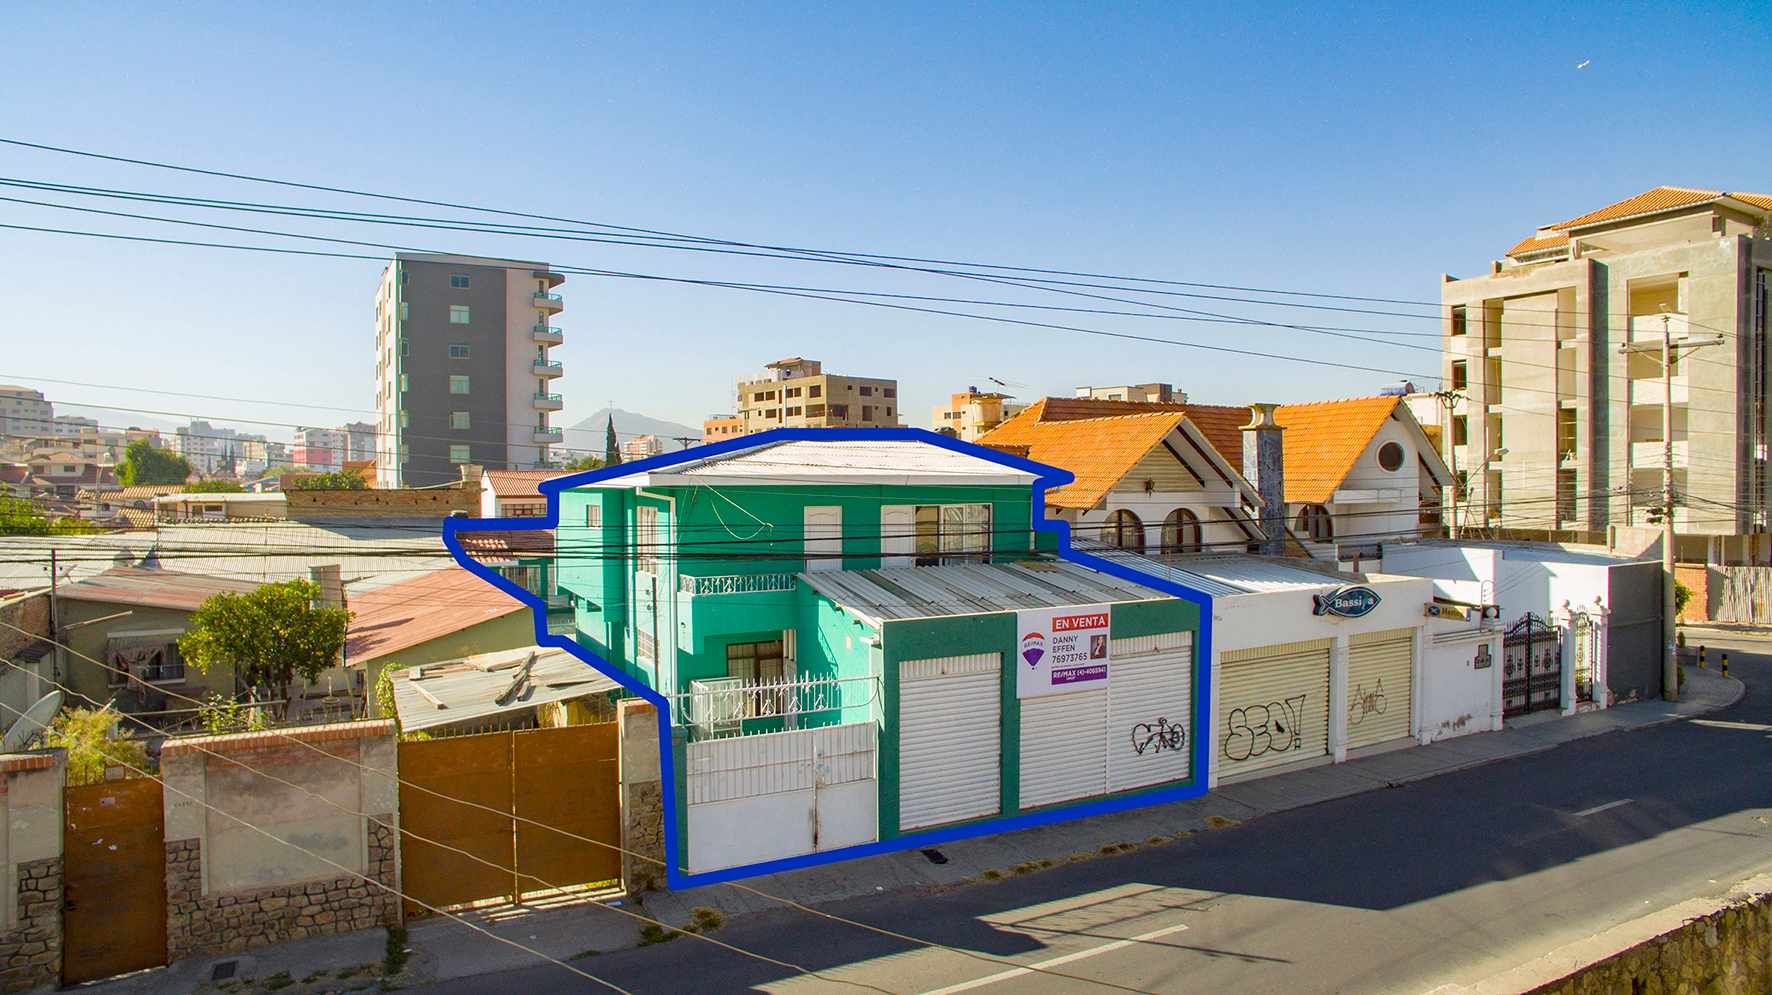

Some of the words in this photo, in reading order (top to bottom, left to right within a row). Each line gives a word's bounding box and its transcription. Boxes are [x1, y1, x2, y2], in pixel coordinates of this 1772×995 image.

[1055, 619, 1070, 629] EN
[1072, 616, 1106, 628] VENTA
[1052, 635, 1078, 645] DANNY
[1052, 644, 1075, 653] EFFEN
[1052, 652, 1087, 664] 76973765
[1053, 669, 1076, 679] RE/MAX
